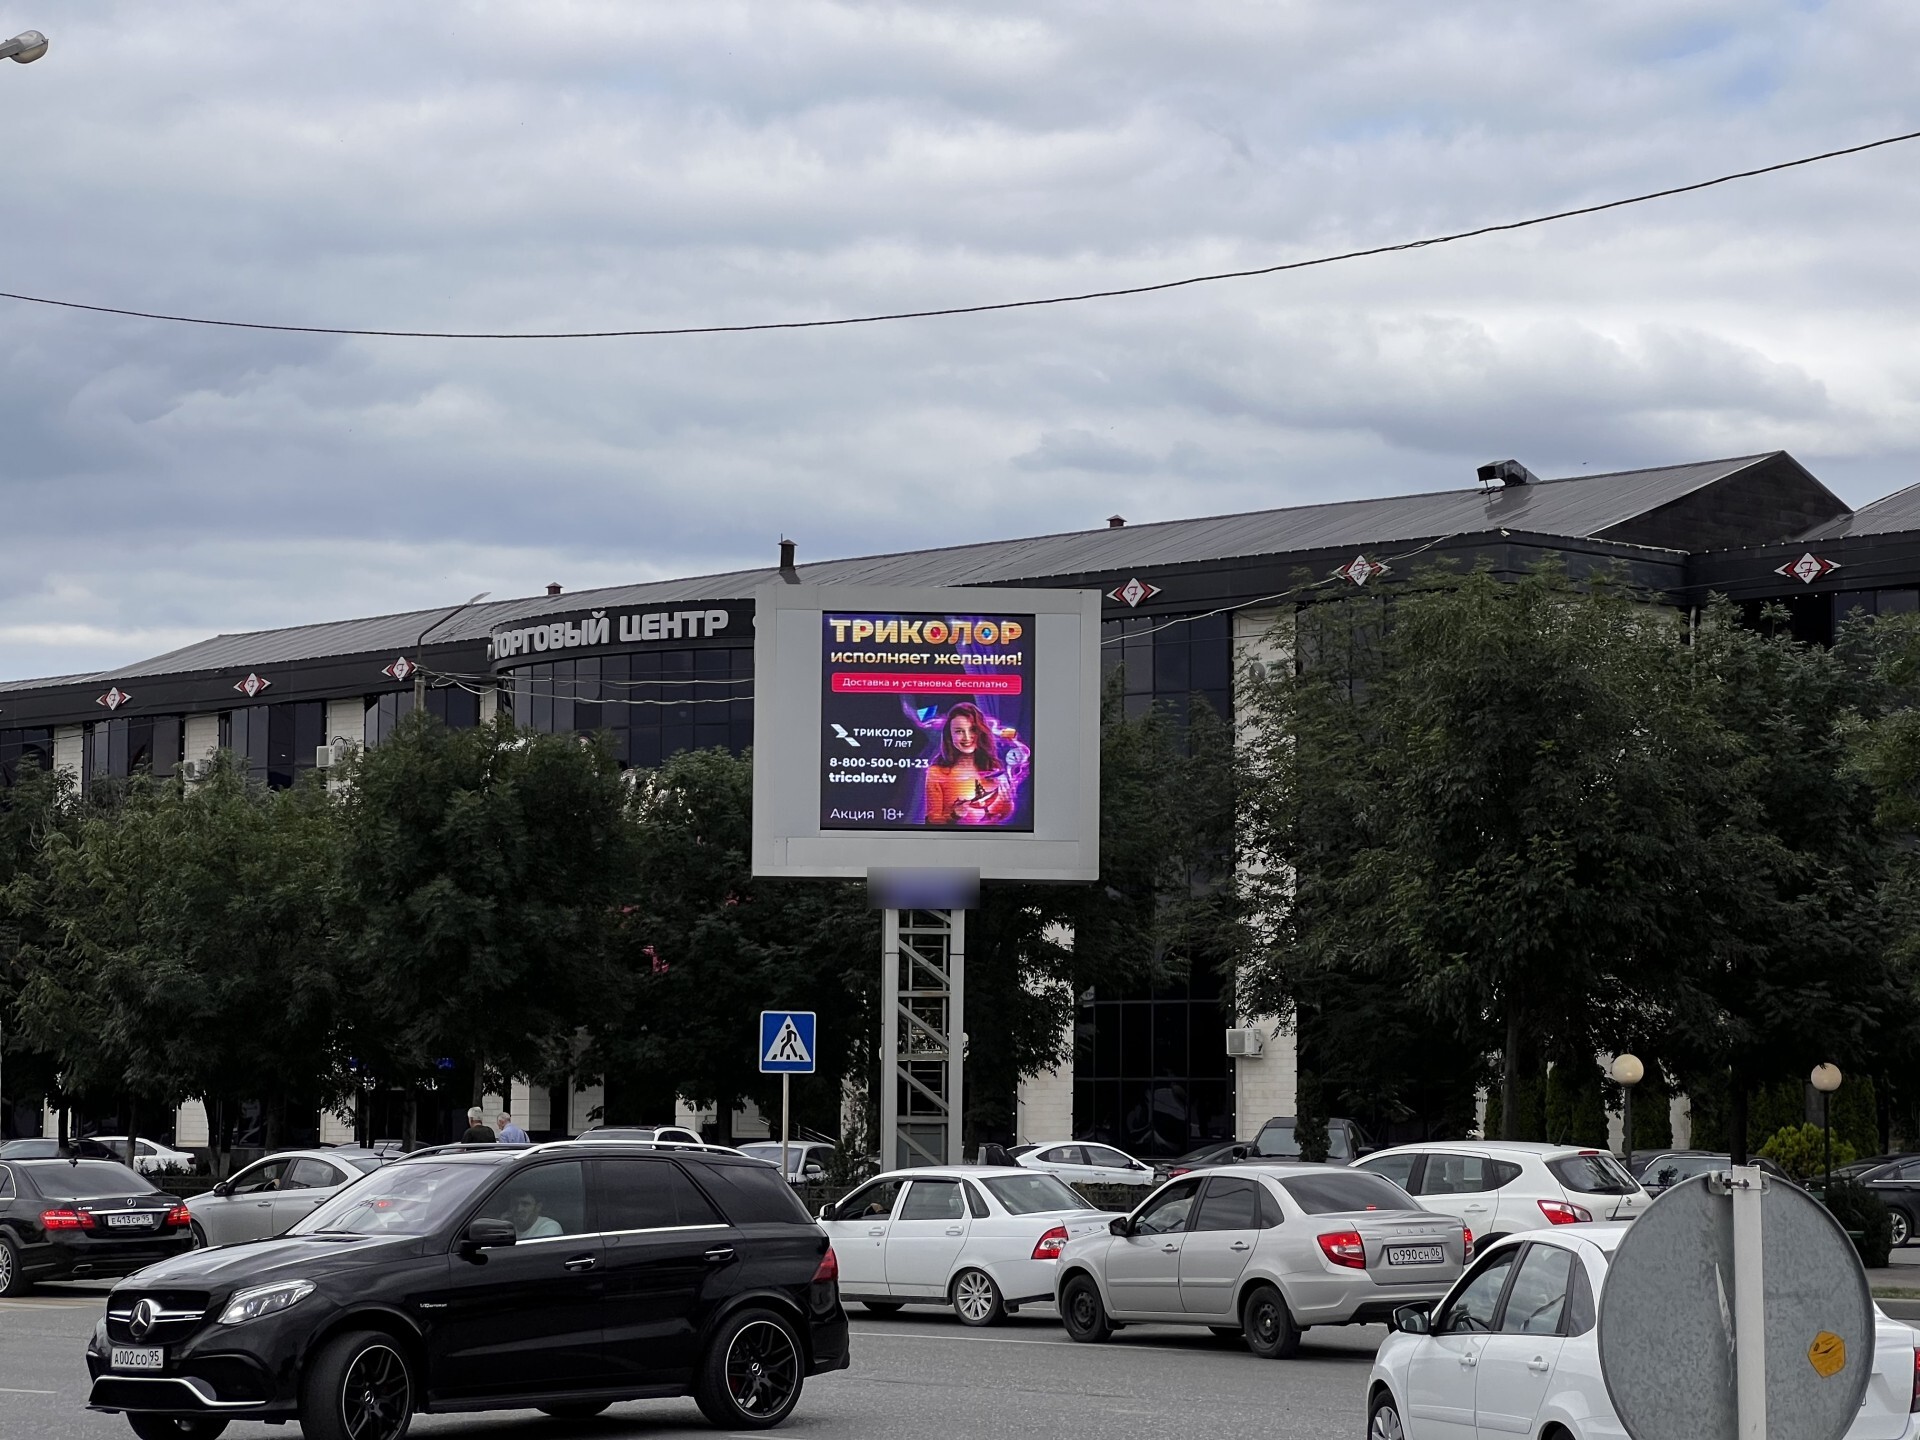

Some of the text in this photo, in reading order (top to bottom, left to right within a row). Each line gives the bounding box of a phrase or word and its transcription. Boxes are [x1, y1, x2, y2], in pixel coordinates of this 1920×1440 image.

[493, 609, 729, 660] ТОРГОВЫЙ ЦЕНТР
[830, 618, 1022, 645] ТРИКОЛОР
[831, 651, 1022, 666] исполняет желания!
[842, 677, 890, 687] Доставка
[901, 679, 953, 689] установка
[955, 679, 1008, 688] бесплатно
[853, 728, 913, 737] ТРИКОЛОР
[883, 739, 912, 748] 17 лет
[829, 757, 930, 769] 8-800-500-01-23
[829, 771, 897, 783] tricolor.tv
[830, 808, 904, 821] Акция 18+
